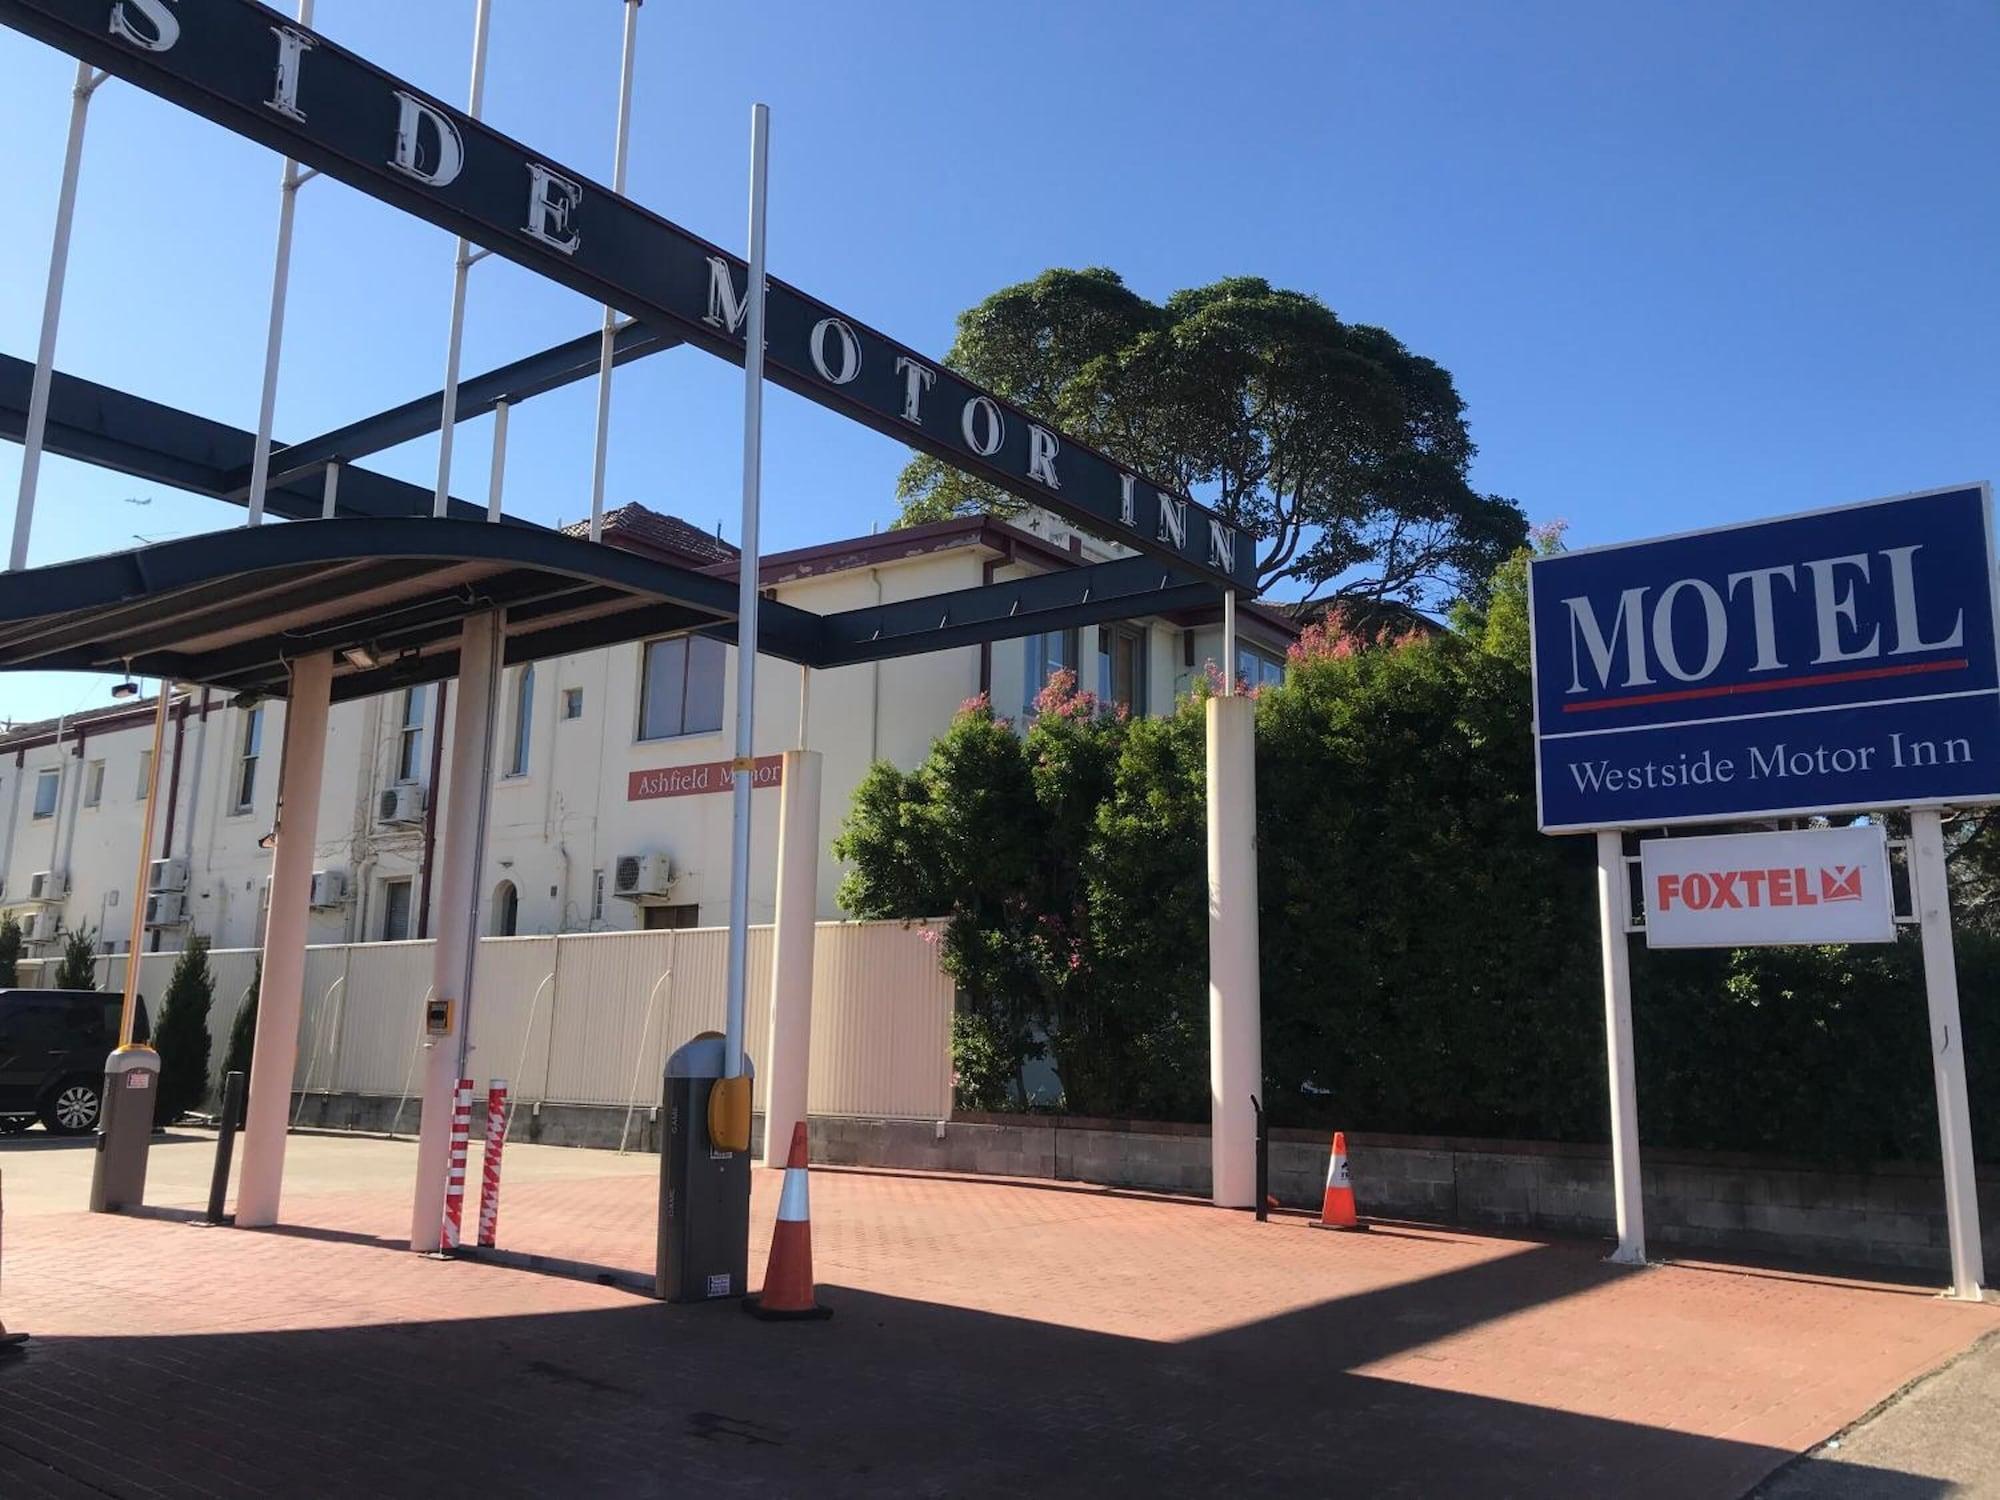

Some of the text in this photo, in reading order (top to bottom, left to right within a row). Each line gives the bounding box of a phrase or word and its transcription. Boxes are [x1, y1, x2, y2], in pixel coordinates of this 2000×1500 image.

[701, 256, 1061, 489] MOTOR
[1118, 474, 1237, 576] INN
[1562, 545, 1963, 694] MOTEL
[638, 764, 781, 795] Ashfield Mnor
[1569, 732, 1974, 794] Westside Motor Inn
[1657, 867, 1817, 912] FOXTEL
